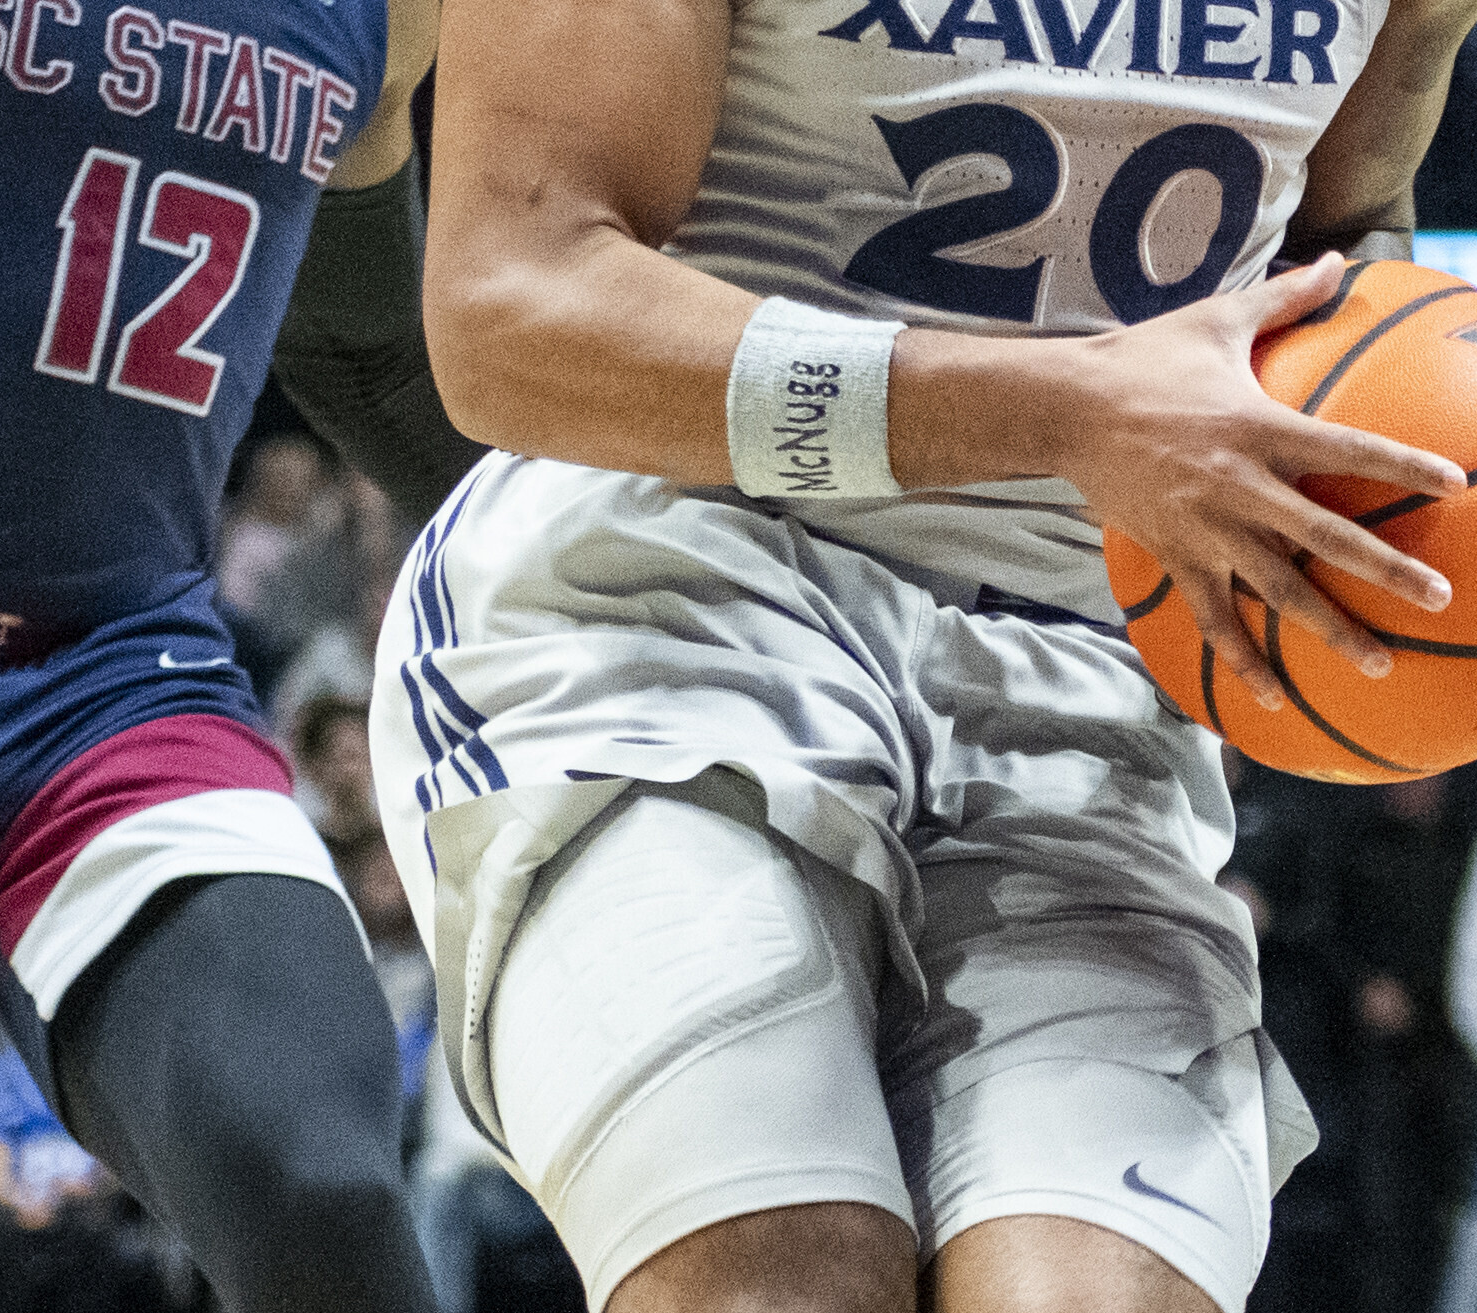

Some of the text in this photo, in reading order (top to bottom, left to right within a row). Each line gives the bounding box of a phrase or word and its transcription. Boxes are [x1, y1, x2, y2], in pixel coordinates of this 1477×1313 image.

[98, 4, 358, 184] STATE
[33, 146, 261, 418] 12
[841, 101, 1271, 327] 20
